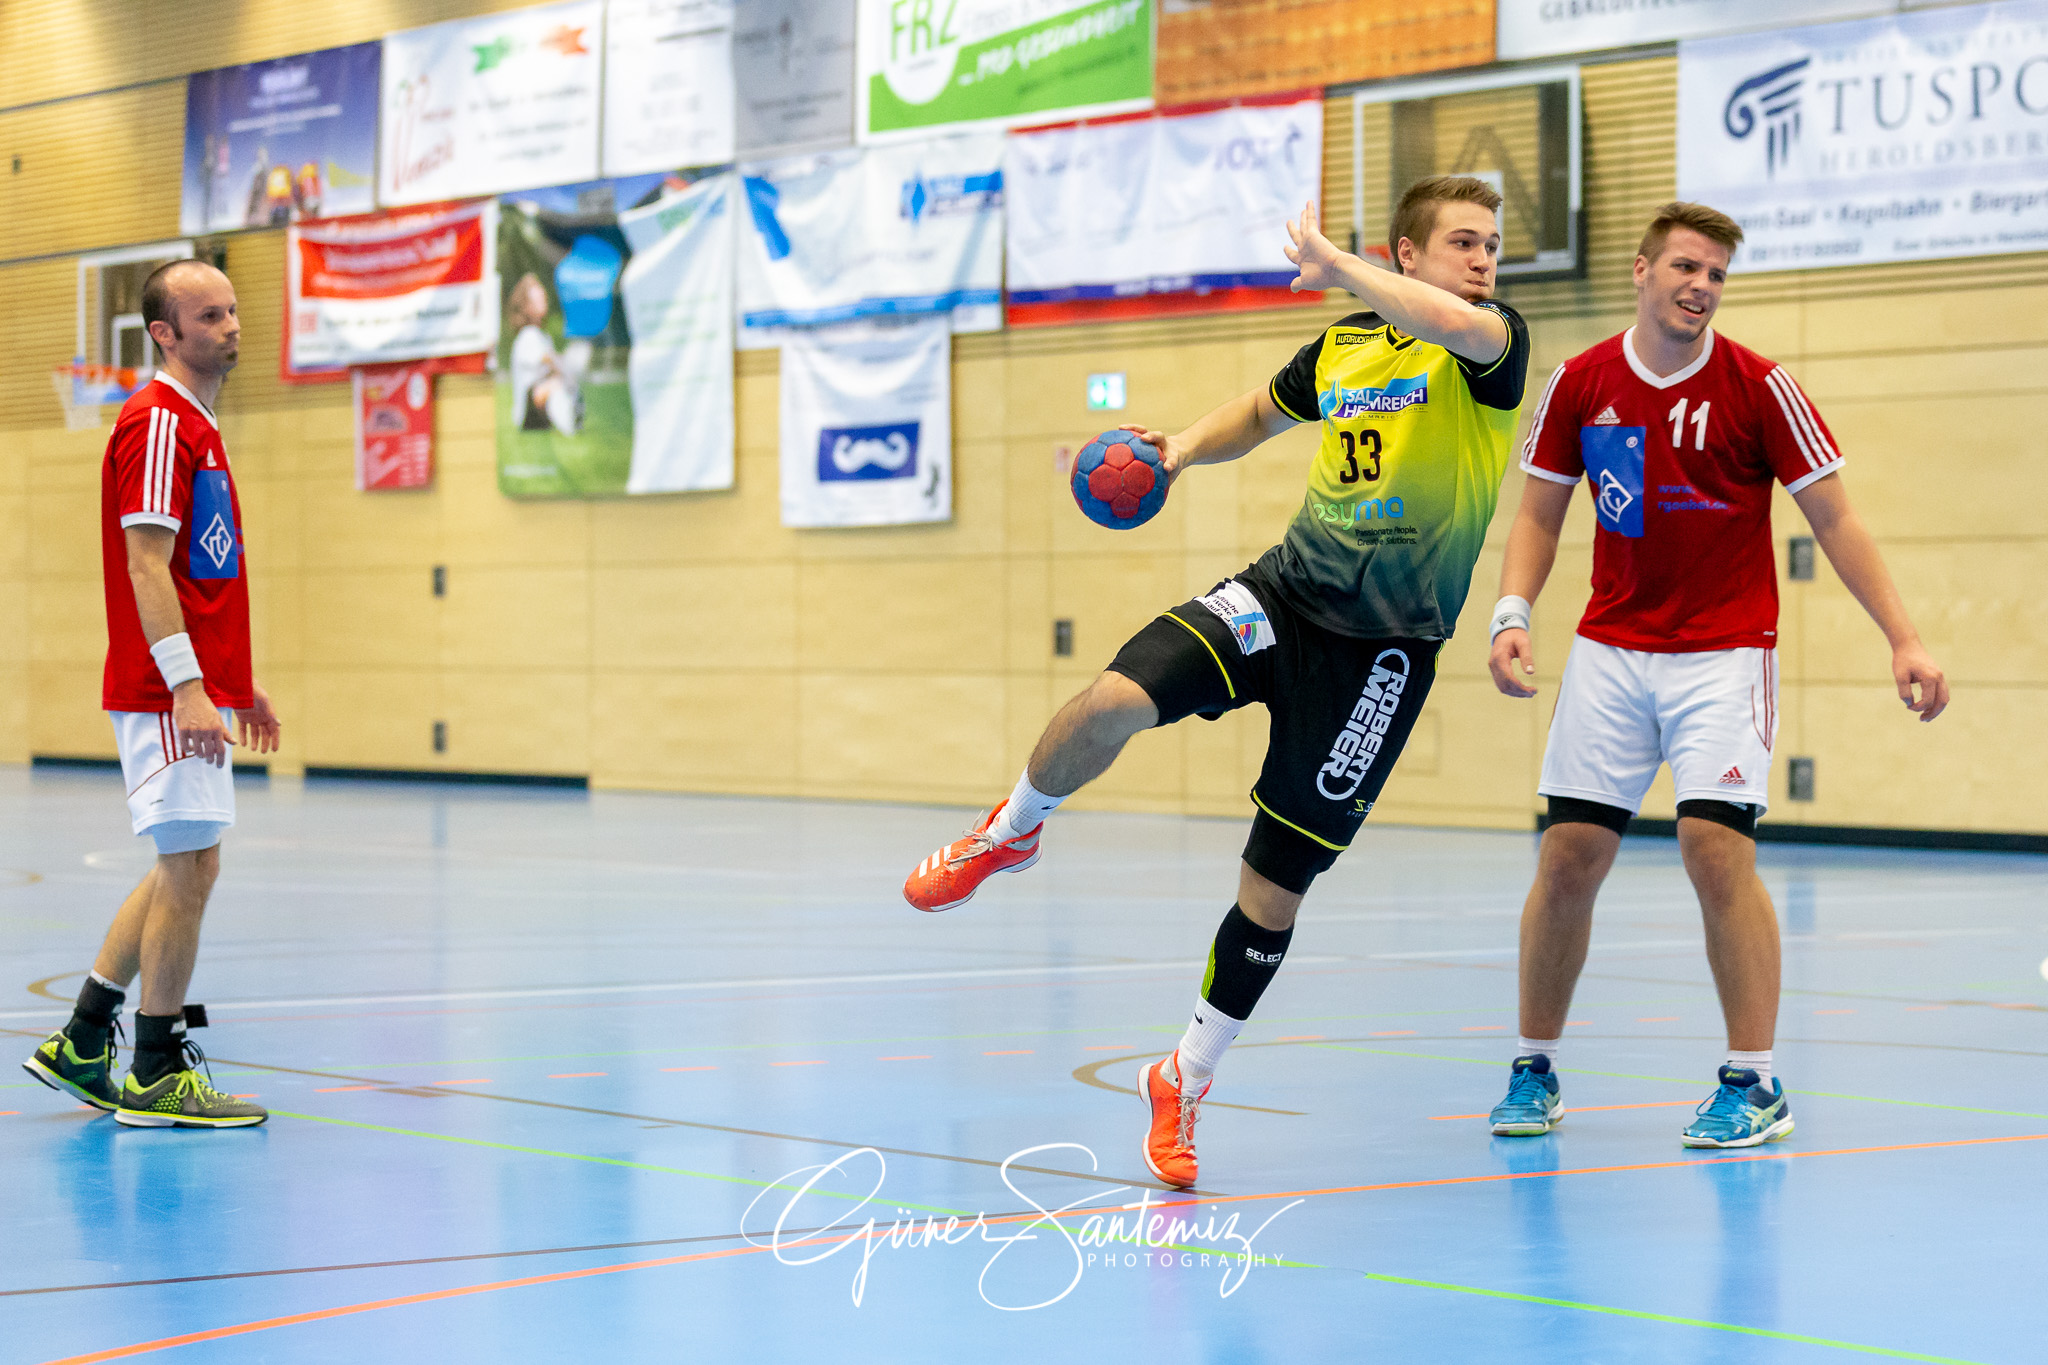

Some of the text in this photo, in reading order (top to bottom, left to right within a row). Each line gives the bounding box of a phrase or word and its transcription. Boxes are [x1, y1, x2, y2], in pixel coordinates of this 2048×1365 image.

[1818, 131, 2048, 172] HEROLDSBER
[1343, 388, 1425, 418] HEMREICH
[1668, 397, 1711, 451] 11
[1339, 428, 1383, 485] 33
[1321, 663, 1393, 779] MEIER
[1345, 671, 1408, 789] ROBERT
[1245, 947, 1283, 963] SELECT
